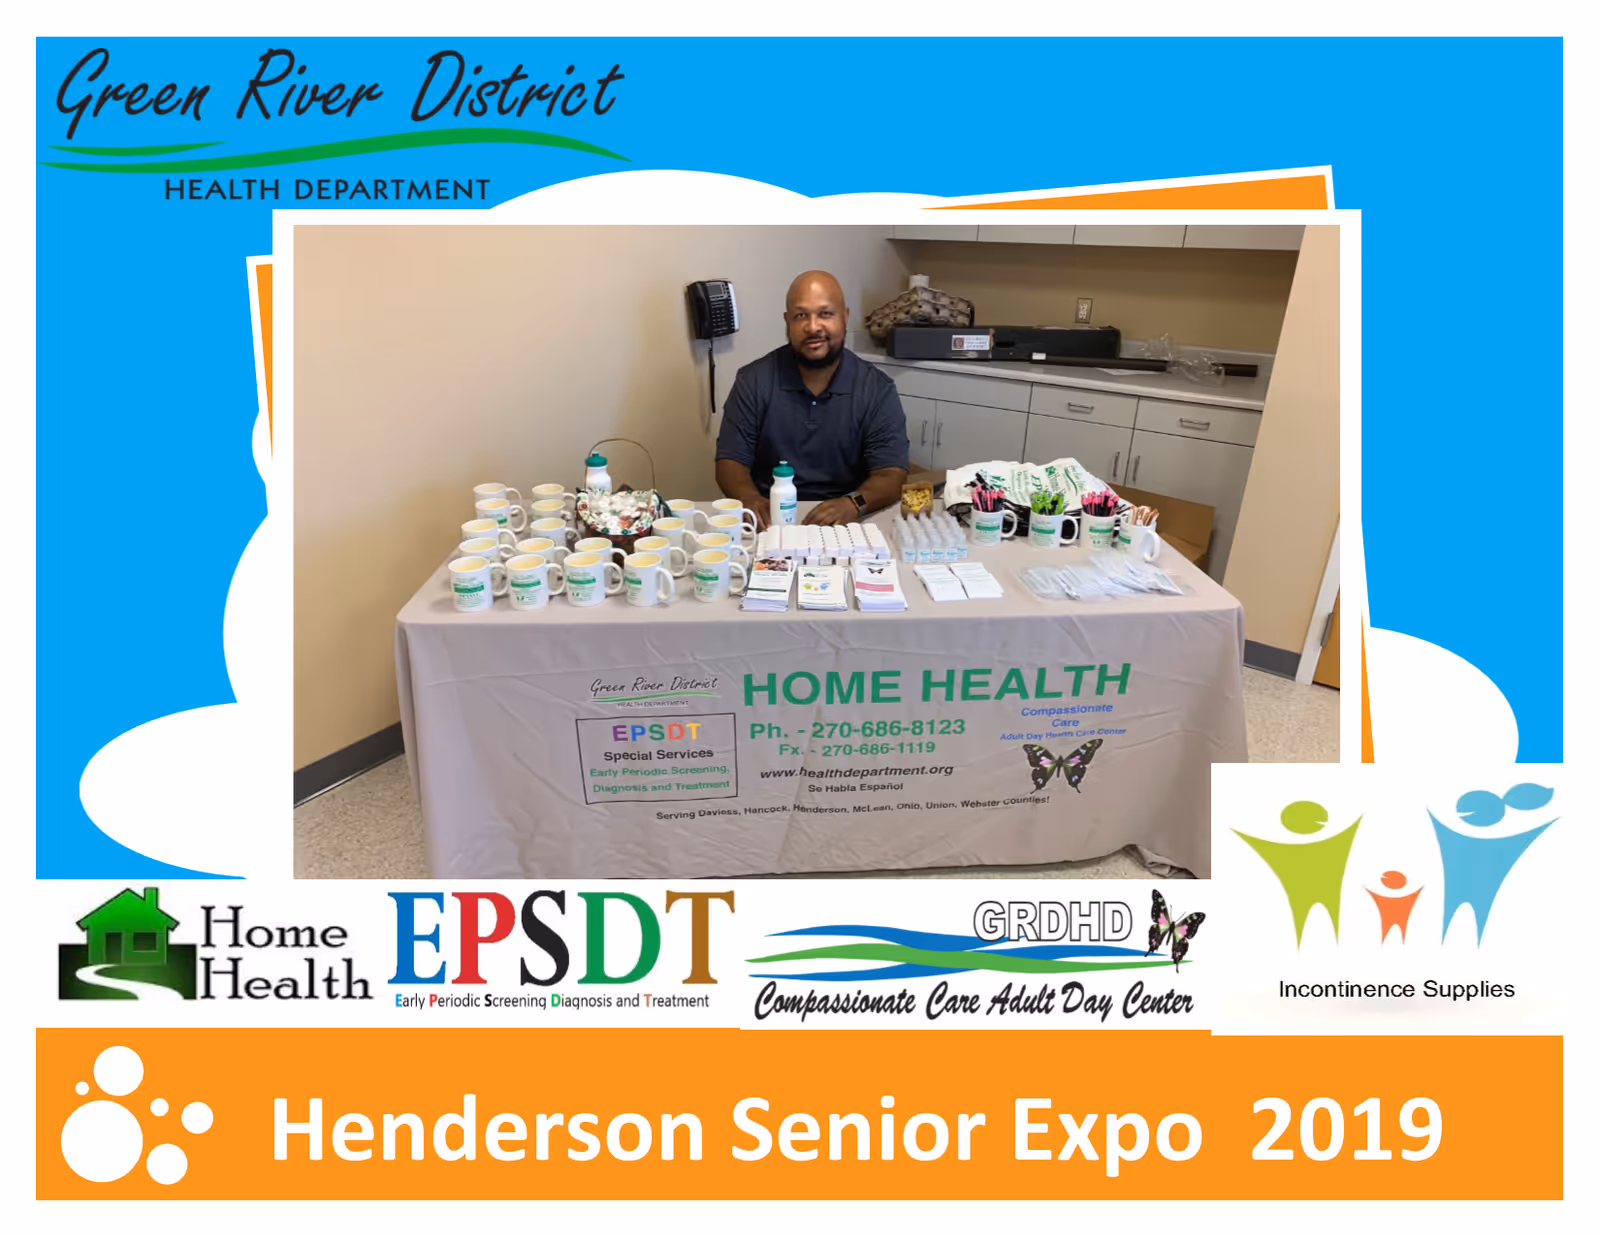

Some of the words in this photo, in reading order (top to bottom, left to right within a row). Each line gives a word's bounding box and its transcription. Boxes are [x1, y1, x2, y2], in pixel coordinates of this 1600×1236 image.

[590, 678, 626, 697] Green
[631, 677, 664, 692] River
[670, 676, 719, 691] District
[743, 670, 902, 706] HOME
[920, 662, 1132, 703] HEALTH
[644, 700, 689, 708] DEPARTMENT
[1021, 704, 1113, 717] Compassionate
[750, 723, 788, 740] Ph.
[812, 718, 966, 739] 270-686-8123
[1051, 718, 1080, 728] Care
[612, 722, 702, 742] EPSDT
[1000, 733, 1025, 741] Adult
[1026, 733, 1043, 741] Day
[1045, 731, 1074, 739] Health
[1097, 728, 1127, 736] Center
[603, 751, 652, 763] Special
[656, 749, 714, 760] Services
[778, 743, 804, 756] Fx.
[821, 741, 936, 757] 270-686-1119
[590, 768, 619, 778] Early
[622, 767, 668, 777] Periodic
[671, 765, 730, 775] Screening,
[760, 765, 954, 780] www.healthdepartment.org
[592, 784, 648, 795] Diagnosis
[650, 784, 672, 792] and
[674, 780, 730, 791] Treatment
[808, 784, 823, 793] Se
[825, 783, 857, 793] Habla
[860, 782, 904, 793] Español
[656, 811, 696, 821] Serving
[698, 808, 742, 818] Daviess,
[960, 800, 1001, 809] Webster
[1002, 795, 1050, 806] Counties!
